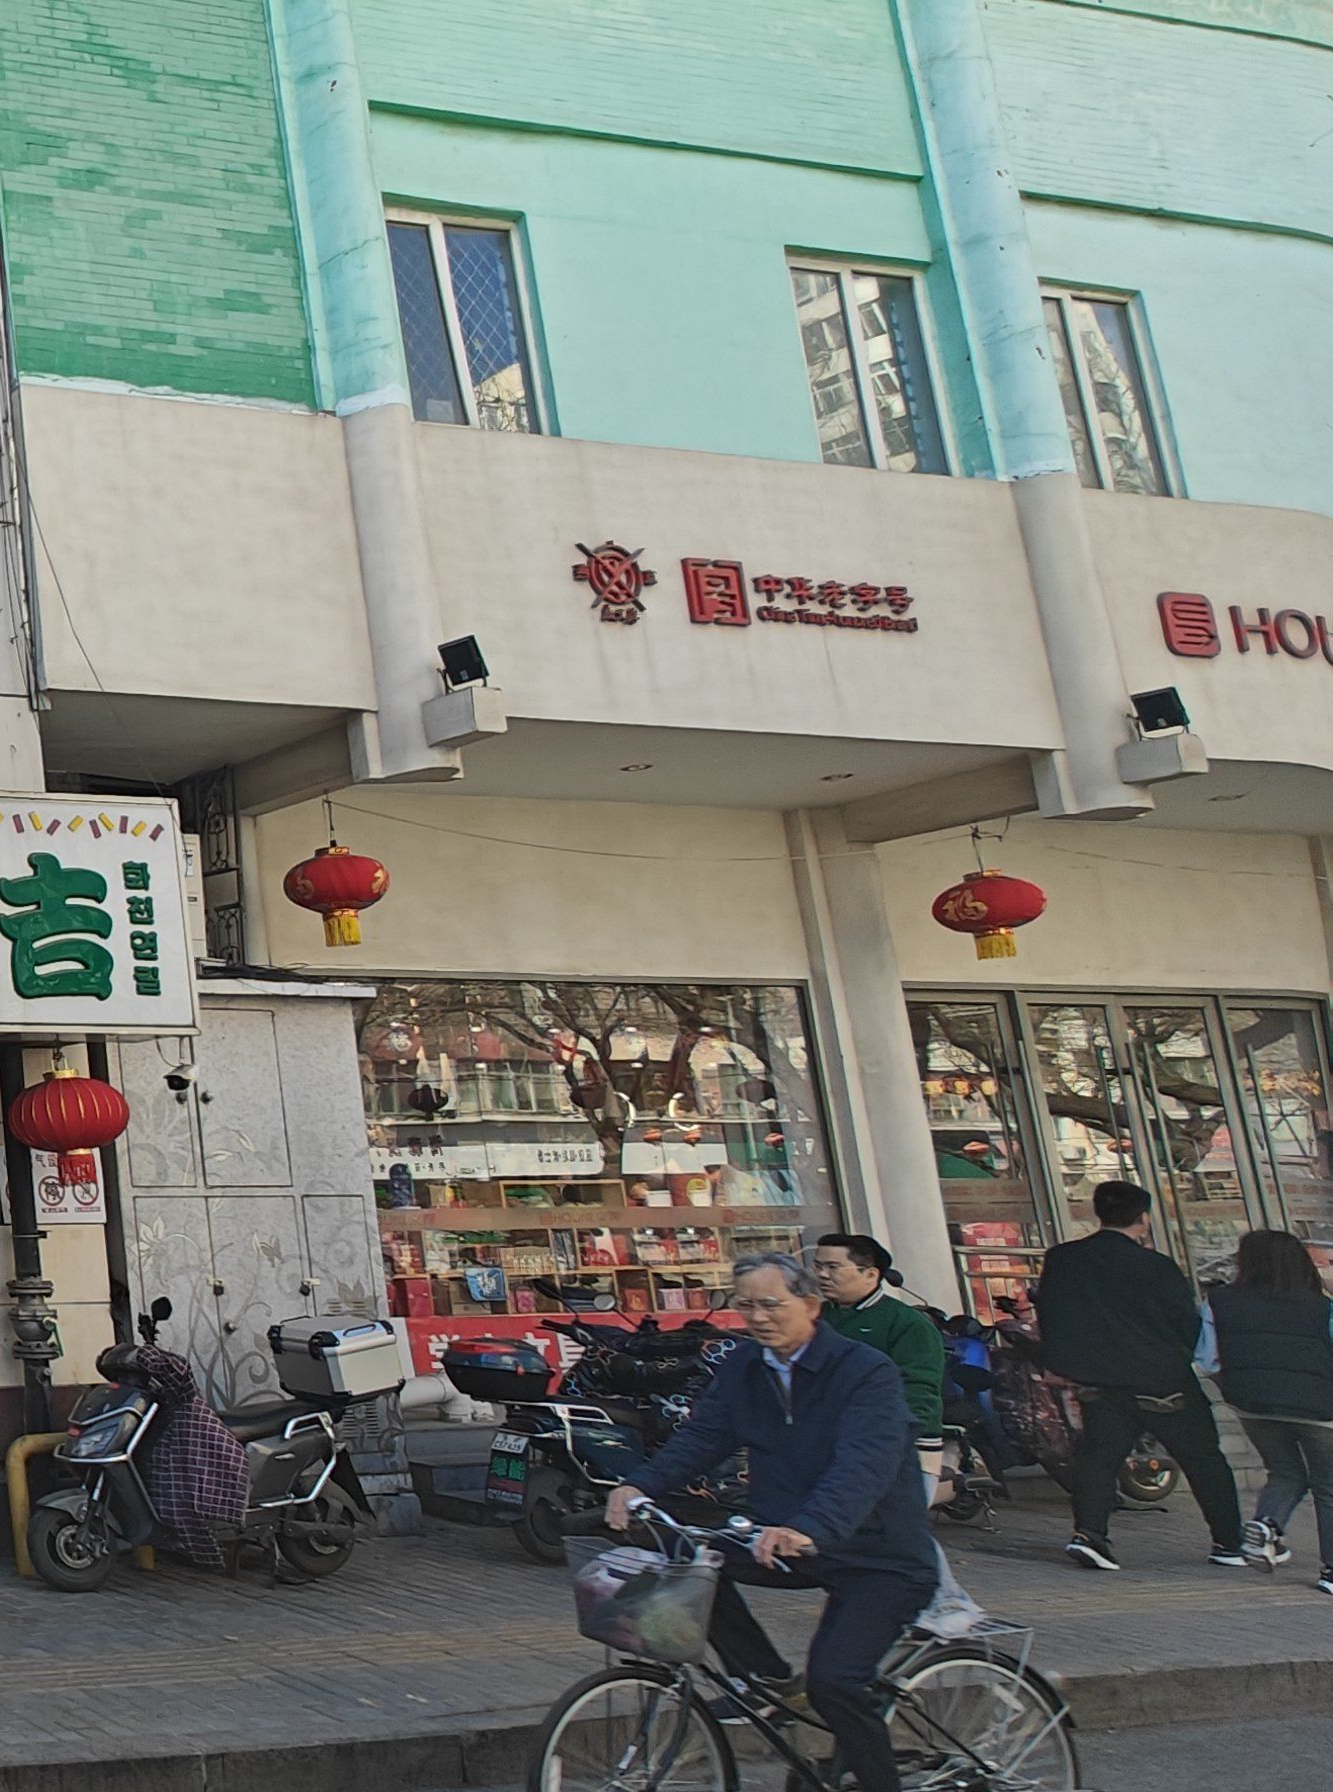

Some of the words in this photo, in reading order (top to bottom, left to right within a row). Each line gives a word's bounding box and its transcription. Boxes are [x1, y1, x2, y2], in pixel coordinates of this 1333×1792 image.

[751, 574, 914, 614] 中华老字号
